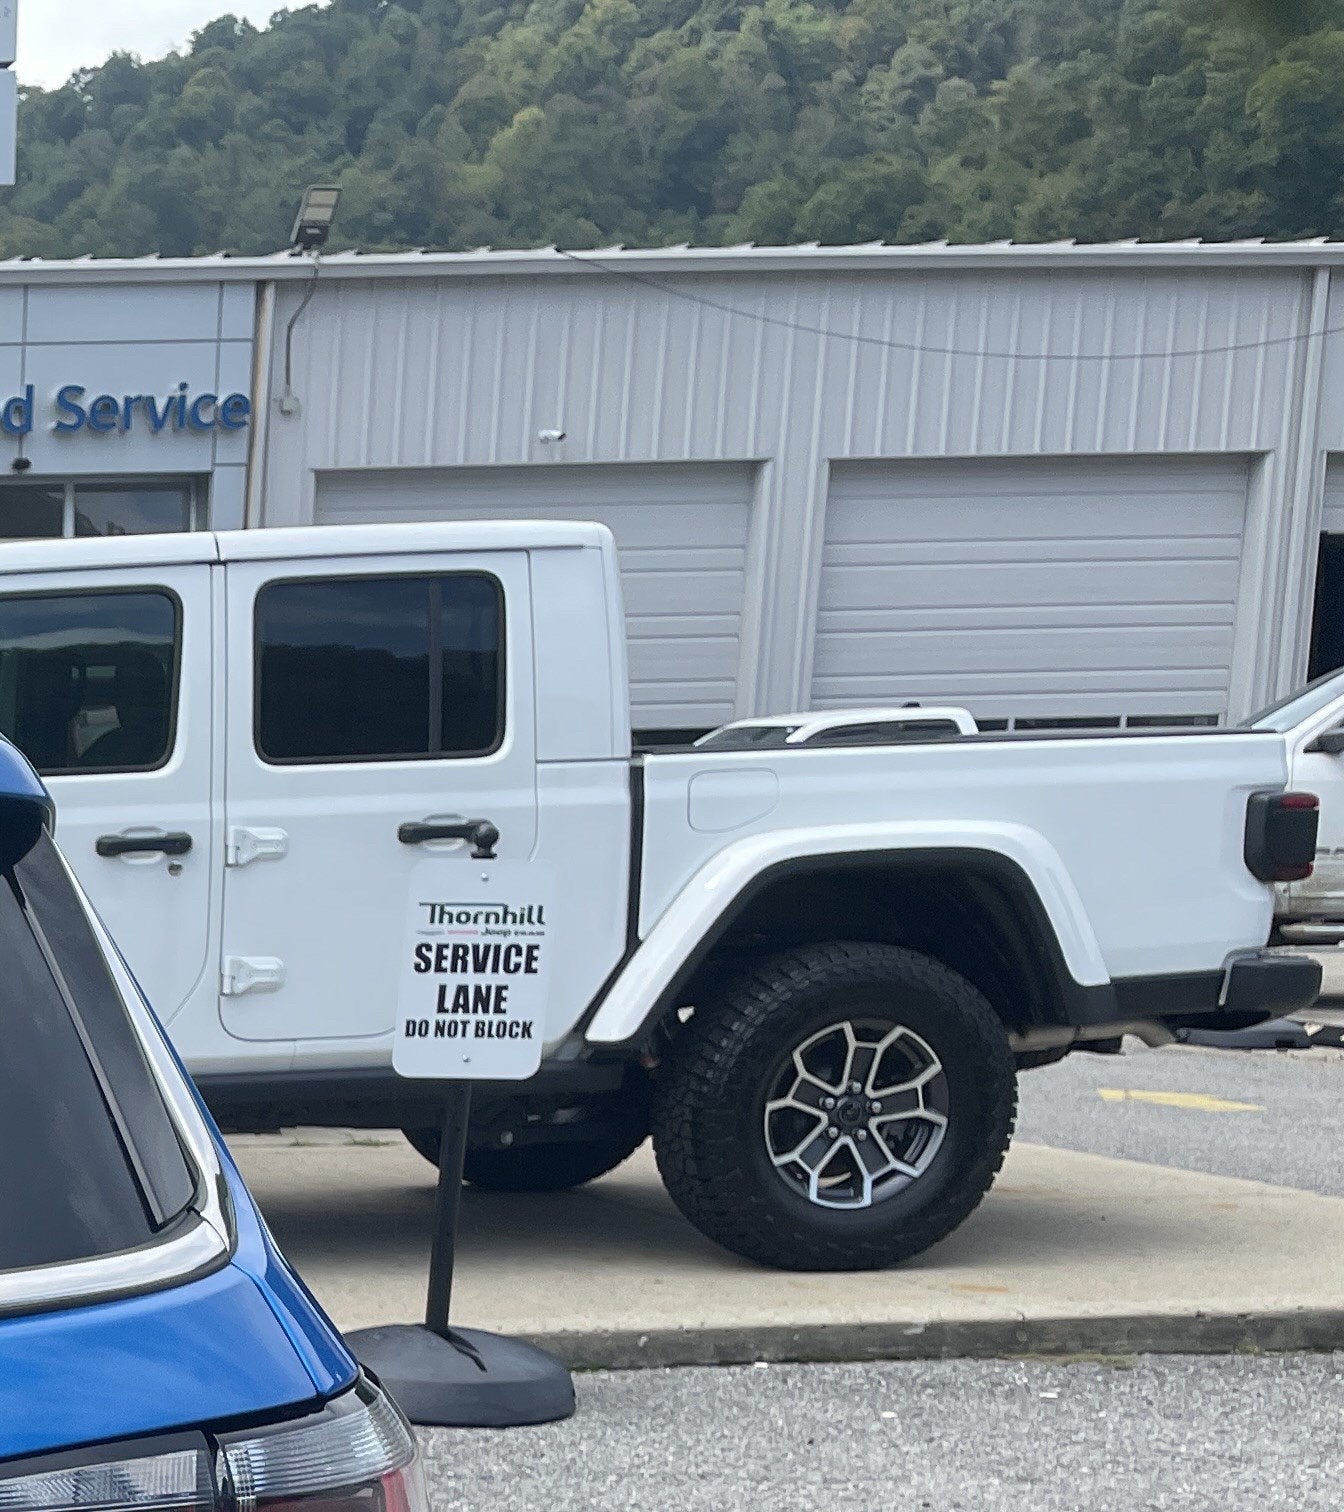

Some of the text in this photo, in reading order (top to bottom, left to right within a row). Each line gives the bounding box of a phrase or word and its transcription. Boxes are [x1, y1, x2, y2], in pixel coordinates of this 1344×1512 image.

[55, 382, 251, 432] Service
[418, 902, 545, 926] Thornhill
[413, 943, 540, 974] SERVICE
[436, 984, 509, 1014] LANE
[405, 1019, 533, 1039] DO NOT BLOCK
